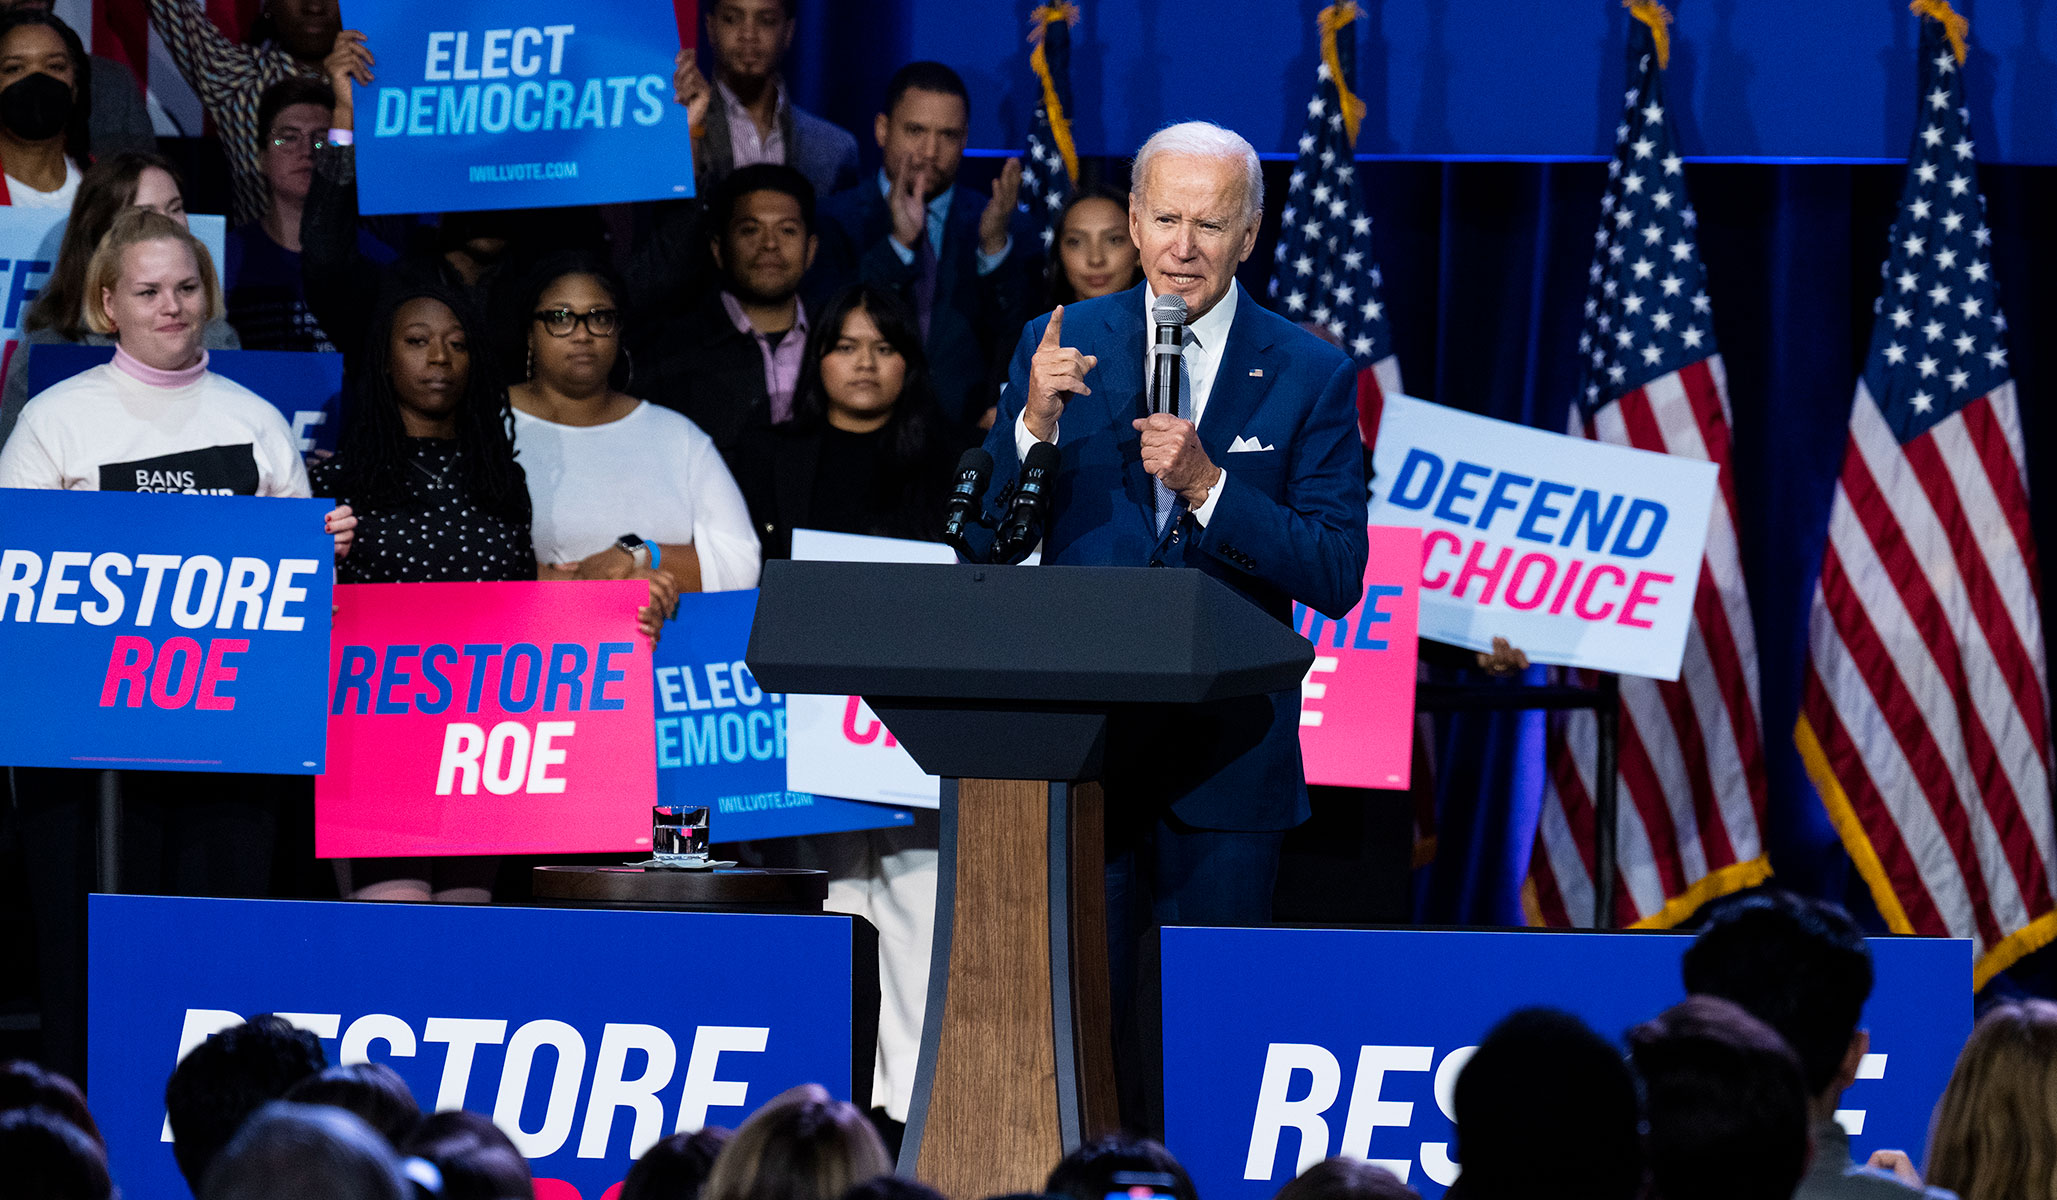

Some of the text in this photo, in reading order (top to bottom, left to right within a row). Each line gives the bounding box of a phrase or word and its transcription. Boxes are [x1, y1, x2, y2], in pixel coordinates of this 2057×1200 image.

[424, 24, 575, 81] ELECT
[374, 73, 667, 138] DEMOCRATS
[469, 160, 579, 183] IWILLVOTE.COM
[135, 469, 195, 489] BANS
[1387, 447, 1669, 559] DEFEND
[0, 549, 319, 632] RESTORE
[1419, 529, 1675, 630] CHOICE
[99, 635, 250, 711] ROE
[331, 641, 635, 715] RESTORE
[655, 659, 782, 712] ELEC
[435, 720, 576, 795] ROE
[718, 791, 815, 814] IWILLVOTE.COM
